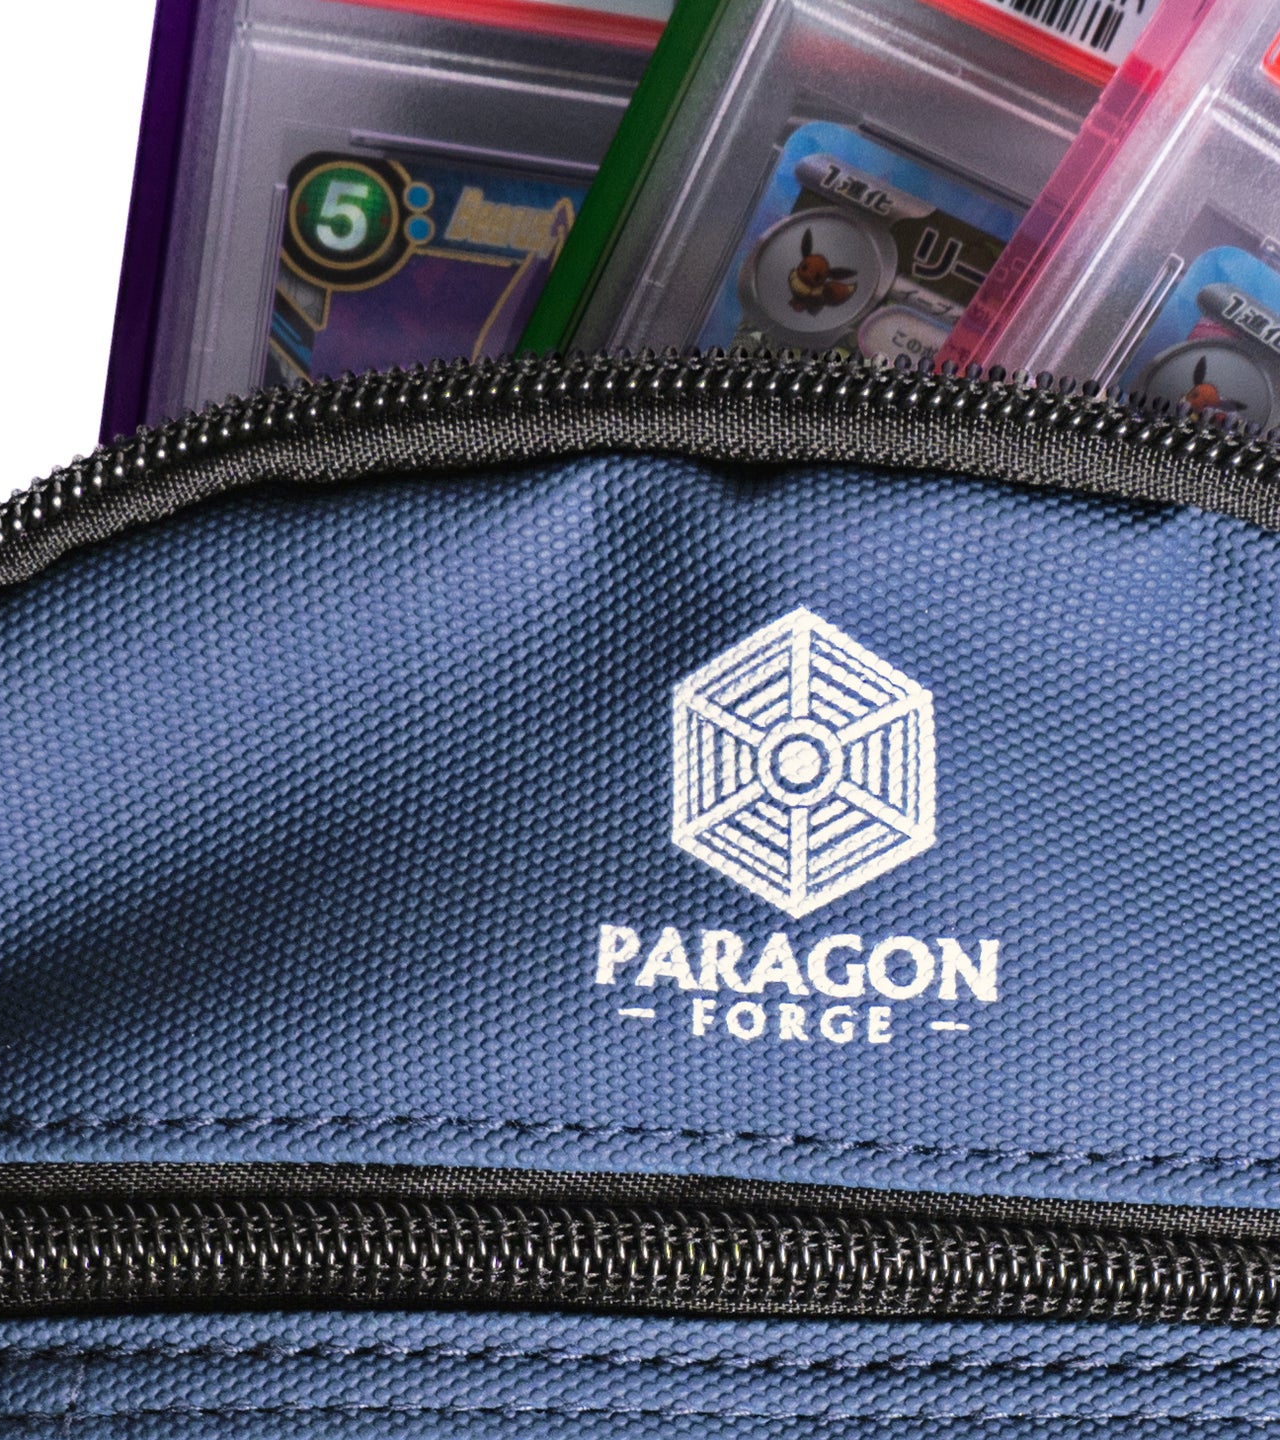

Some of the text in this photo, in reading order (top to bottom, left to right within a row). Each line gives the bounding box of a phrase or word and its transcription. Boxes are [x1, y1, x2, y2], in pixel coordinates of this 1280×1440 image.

[316, 180, 369, 252] 5
[595, 924, 1000, 1003] PARAGON
[691, 998, 894, 1043] FORGE
